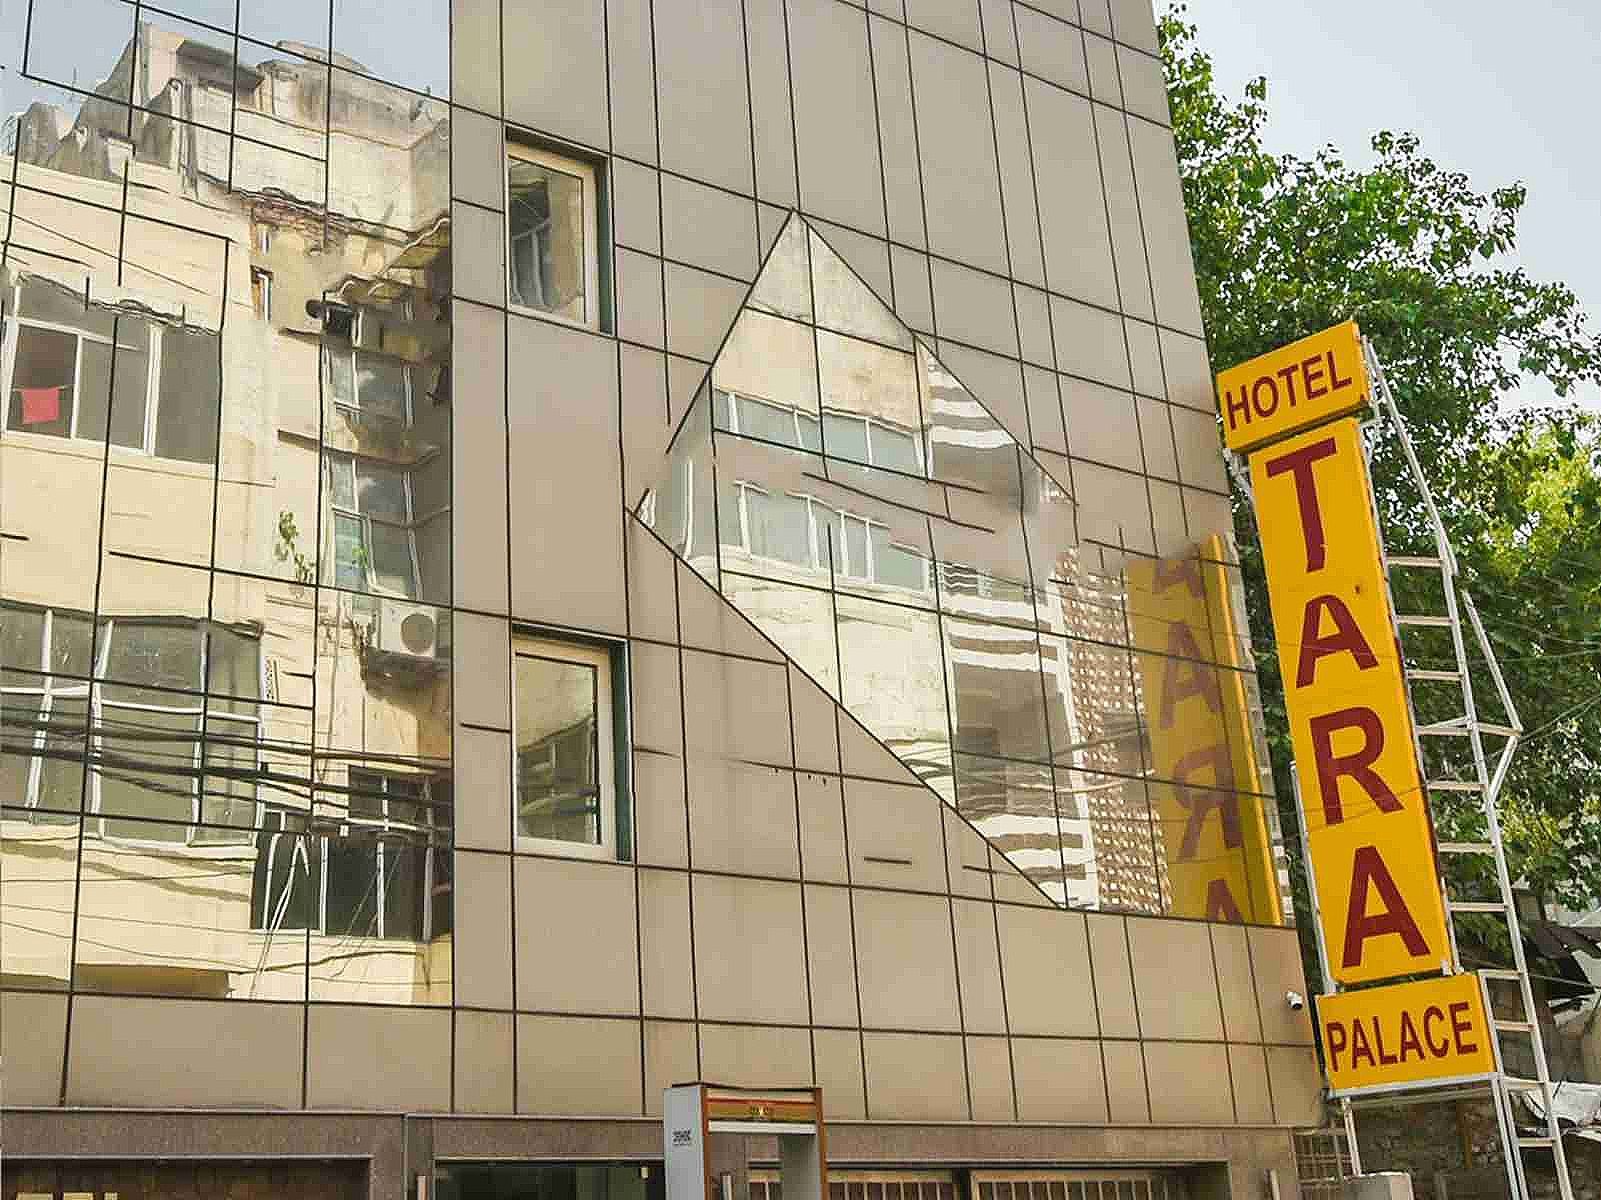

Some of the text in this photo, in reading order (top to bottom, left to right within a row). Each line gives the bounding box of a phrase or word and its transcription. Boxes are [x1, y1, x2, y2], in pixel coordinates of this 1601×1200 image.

[1225, 351, 1353, 431] HOTEL
[1265, 437, 1431, 969] TARA
[1325, 1001, 1478, 1073] PALACE
